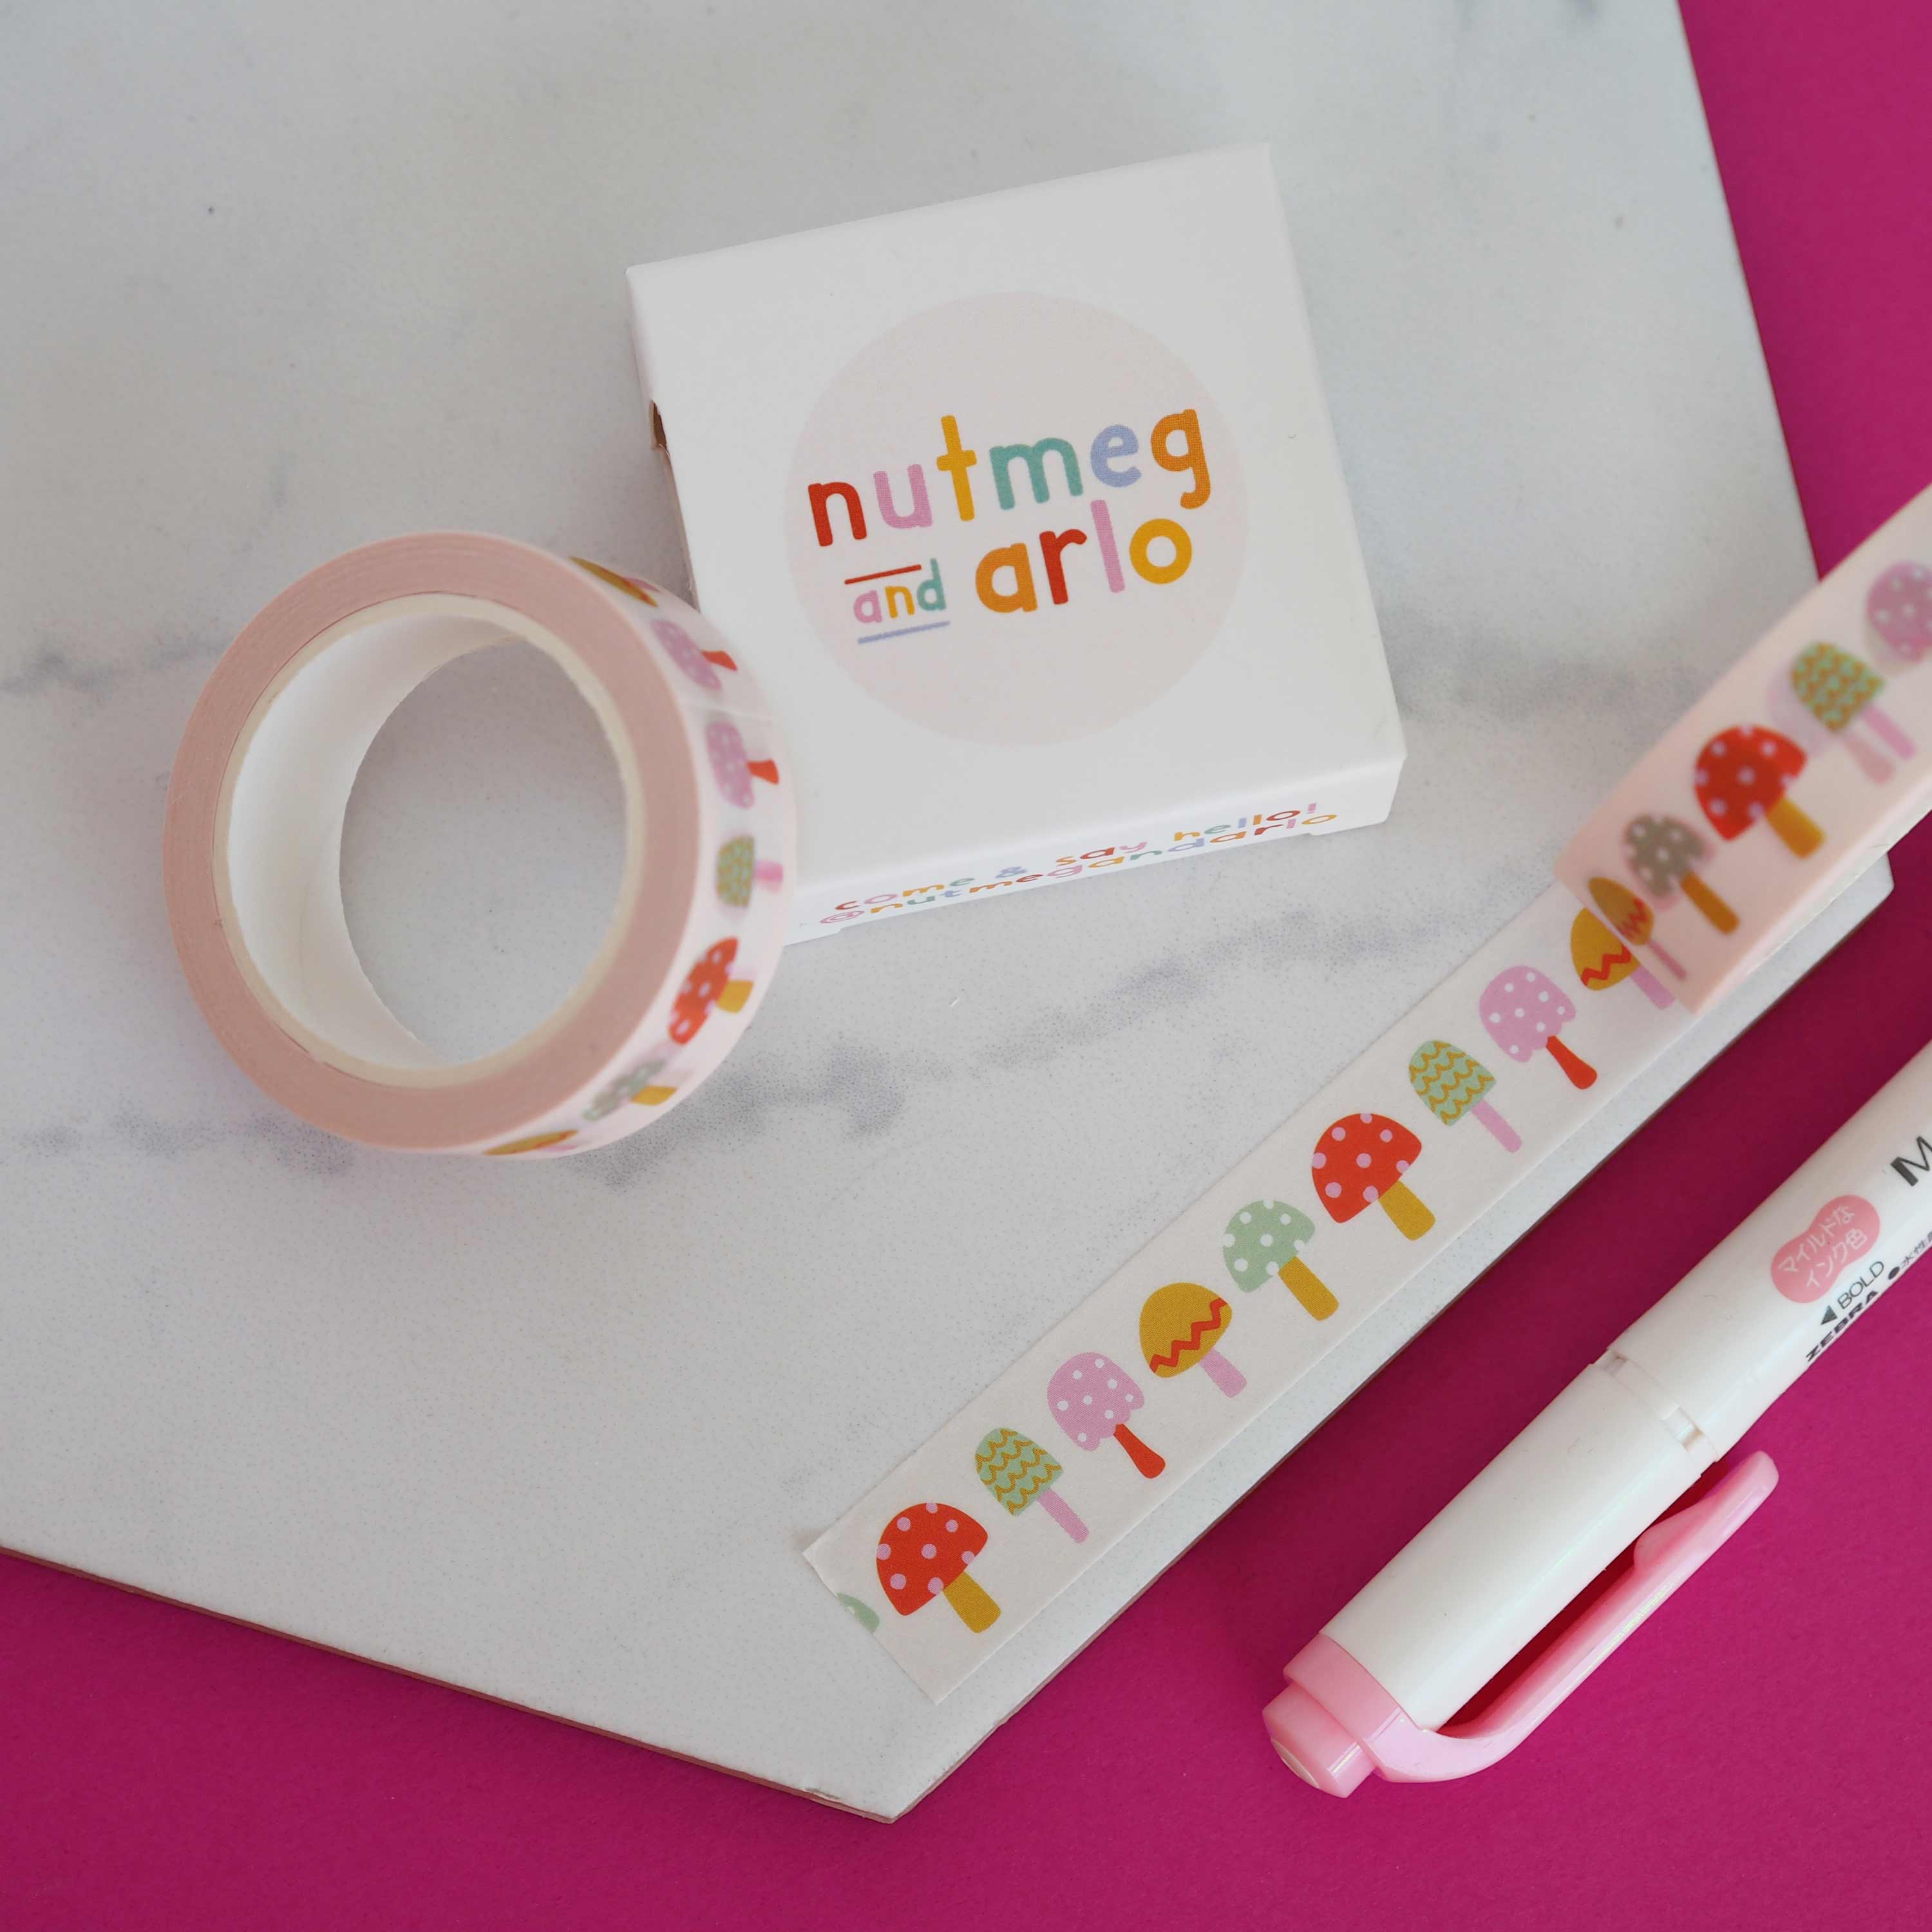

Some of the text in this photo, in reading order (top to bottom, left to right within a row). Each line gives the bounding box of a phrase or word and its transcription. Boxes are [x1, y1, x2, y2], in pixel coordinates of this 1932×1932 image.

[808, 408, 1211, 547] nutmeg
[853, 498, 1192, 624] and arlo
[819, 813, 1338, 924] @nutmegandarlo
[835, 802, 1318, 910] come & say hello!
[1777, 1206, 1855, 1273] マイルドな
[1806, 1227, 1867, 1288] インク色
[1806, 1290, 1879, 1363] ZEBRA
[1837, 1261, 1884, 1310] BOLD
